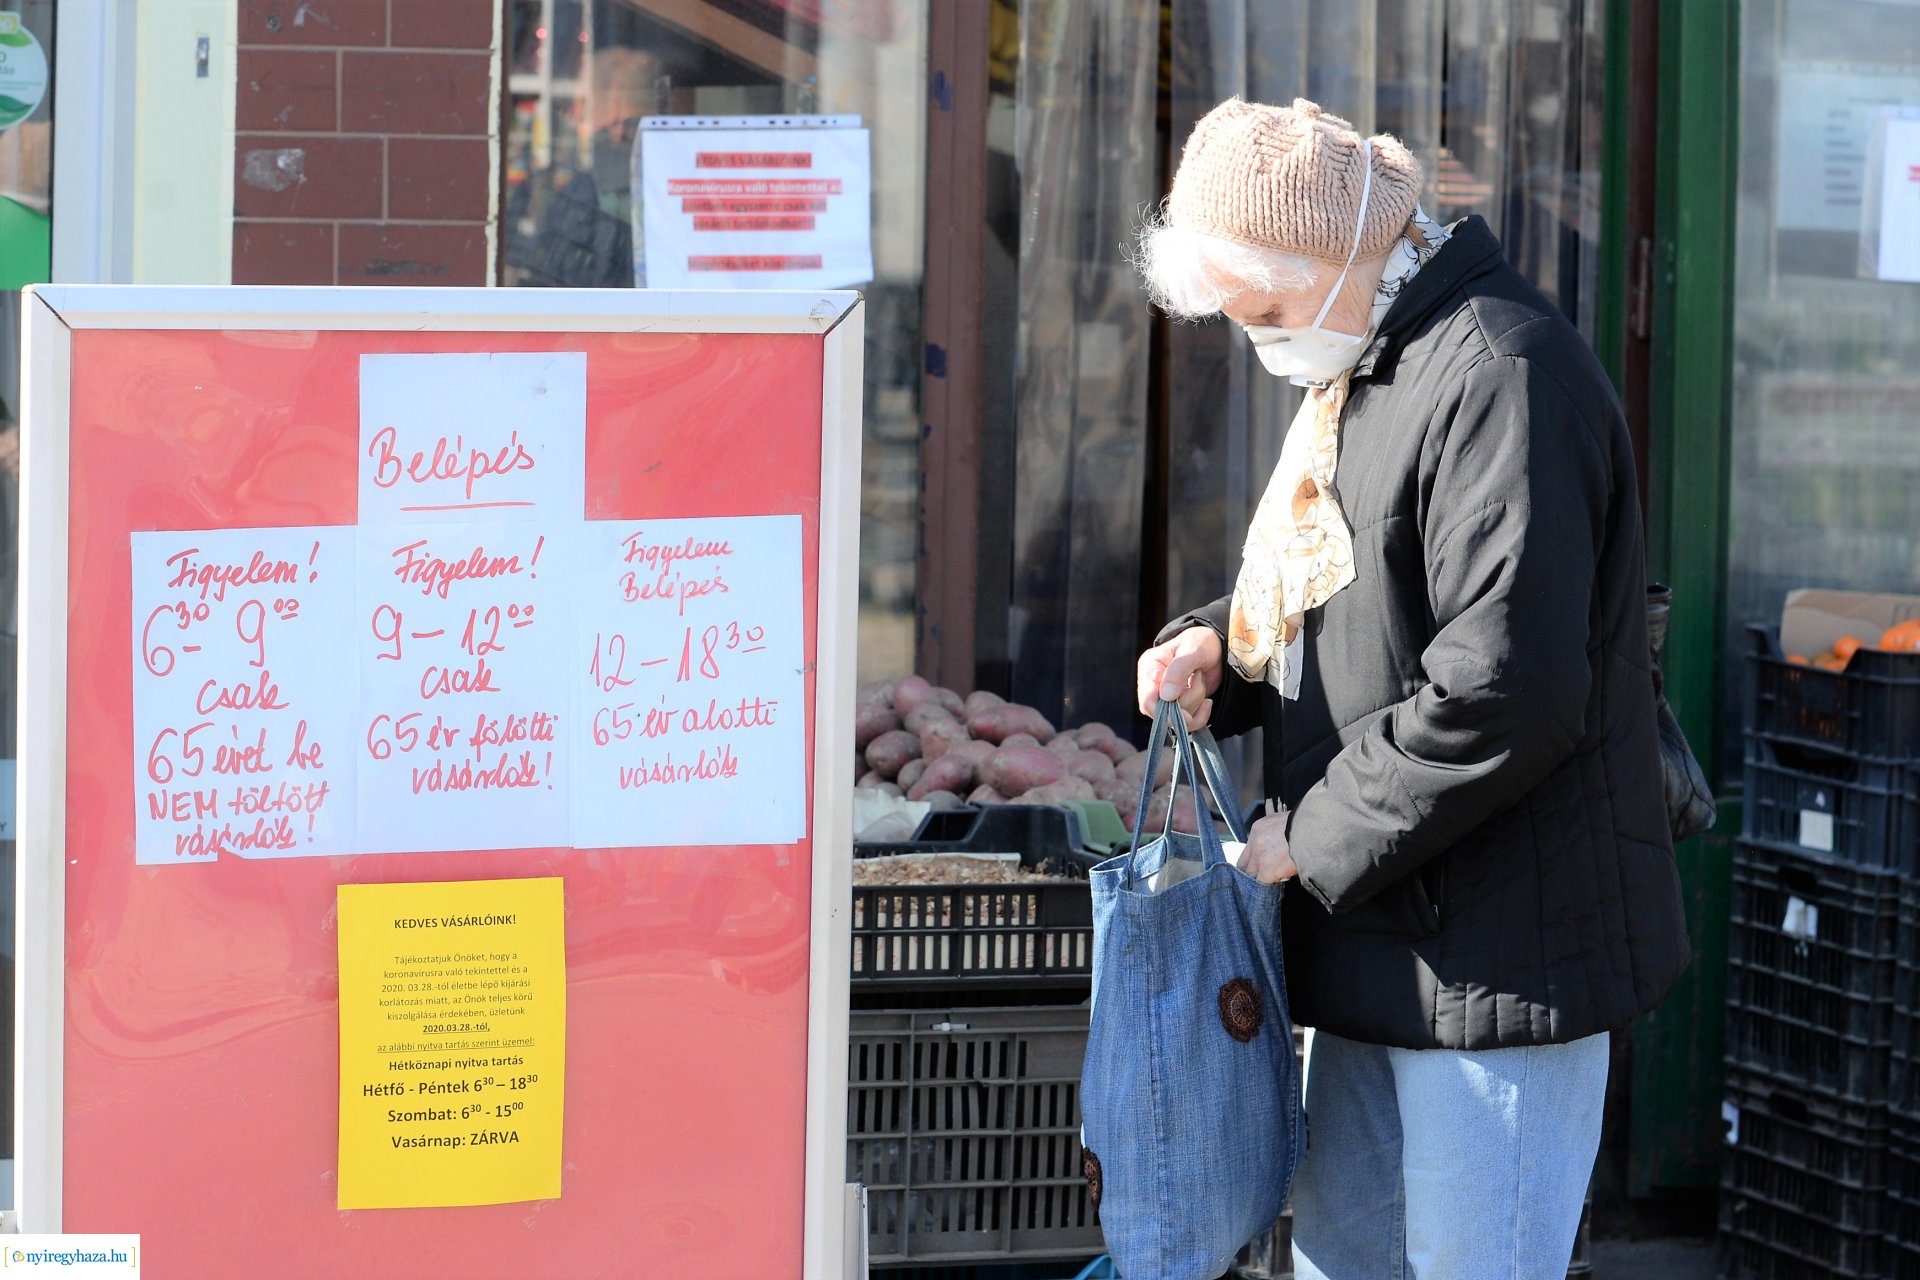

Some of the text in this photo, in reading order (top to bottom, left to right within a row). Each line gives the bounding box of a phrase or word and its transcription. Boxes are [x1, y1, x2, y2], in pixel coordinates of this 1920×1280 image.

[369, 426, 535, 500] Belépés
[620, 531, 735, 577] Figyelem
[166, 540, 320, 602] Figyelem!
[392, 535, 544, 600] Figyelem!
[619, 564, 730, 617] Belépés
[589, 632, 637, 693] 12
[593, 702, 635, 746] 65
[367, 712, 423, 760] 65
[147, 721, 215, 784] 65
[286, 719, 324, 770] be
[619, 743, 740, 790] vásárlók
[147, 780, 330, 822] NEM töltött
[394, 914, 516, 929] KEDVES VÁSÁRLÓINK!
[394, 954, 452, 966] Tájékoztatjuk
[454, 953, 488, 963] Önöket,
[489, 952, 511, 962] hogy
[384, 969, 443, 979] koronavírusra
[445, 967, 463, 977] való
[465, 966, 509, 976] tekintettel
[511, 966, 521, 974] és
[381, 979, 531, 993] 2020. 03.28.-tól életbe lépő kijárási
[379, 997, 423, 1007] korlátozás
[425, 996, 451, 1006] miatt,
[464, 993, 487, 1004] Önök
[489, 993, 512, 1004] teljes
[513, 992, 533, 1001] körű
[387, 1006, 526, 1022] kiszolgálása érdekében, üzletünk
[422, 1022, 491, 1034] 2020.03.28.-tól,
[377, 1036, 536, 1052] az alábbi nyitva tartás szerint üzemel:
[389, 1055, 524, 1072] Hétköznapi nyitva tartás
[363, 1083, 405, 1097] Hétfő
[418, 1079, 470, 1095] Péntek
[387, 1108, 457, 1123] Szombat:
[391, 1130, 520, 1150] Vasárnap: ZÁRVA
